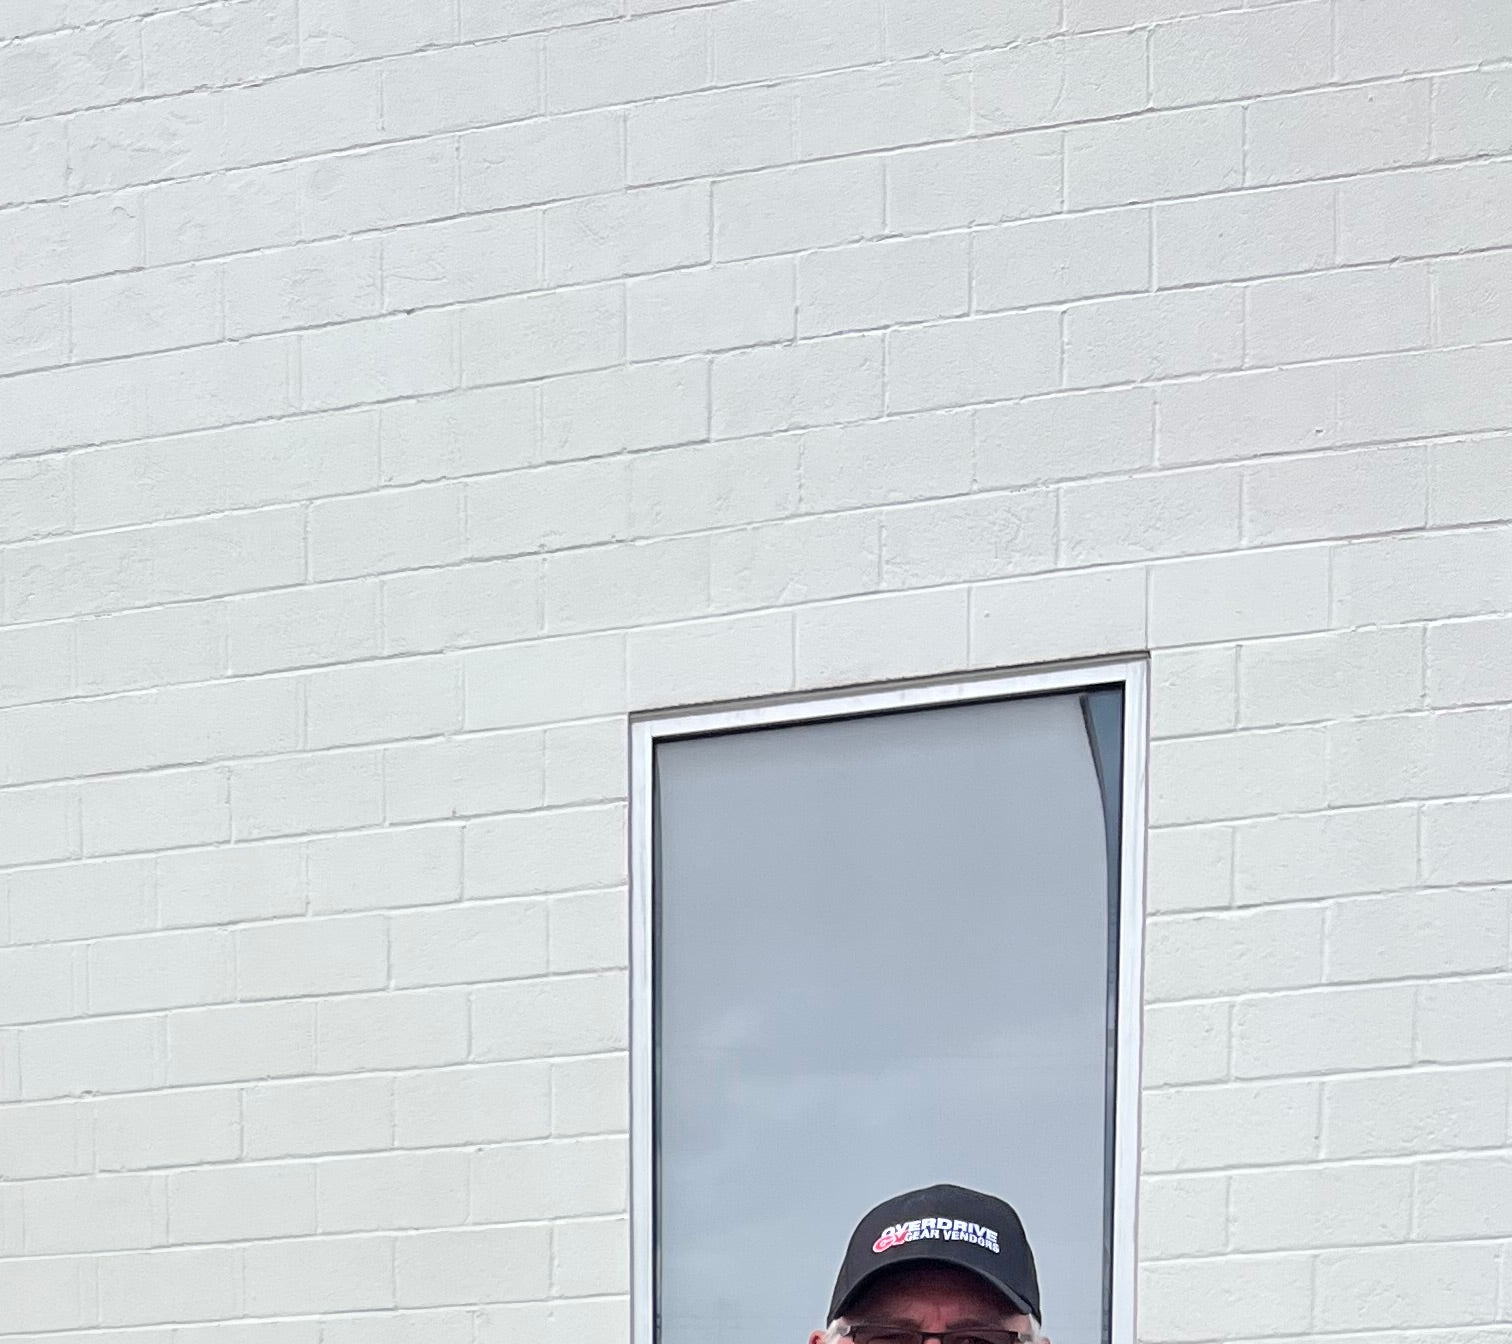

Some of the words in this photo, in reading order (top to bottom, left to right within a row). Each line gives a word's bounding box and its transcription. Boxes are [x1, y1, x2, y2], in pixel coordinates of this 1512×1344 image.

[881, 1217, 999, 1243] OVERDRIVE
[904, 1229, 941, 1242] GEAR
[943, 1229, 1000, 1253] VENDORS
